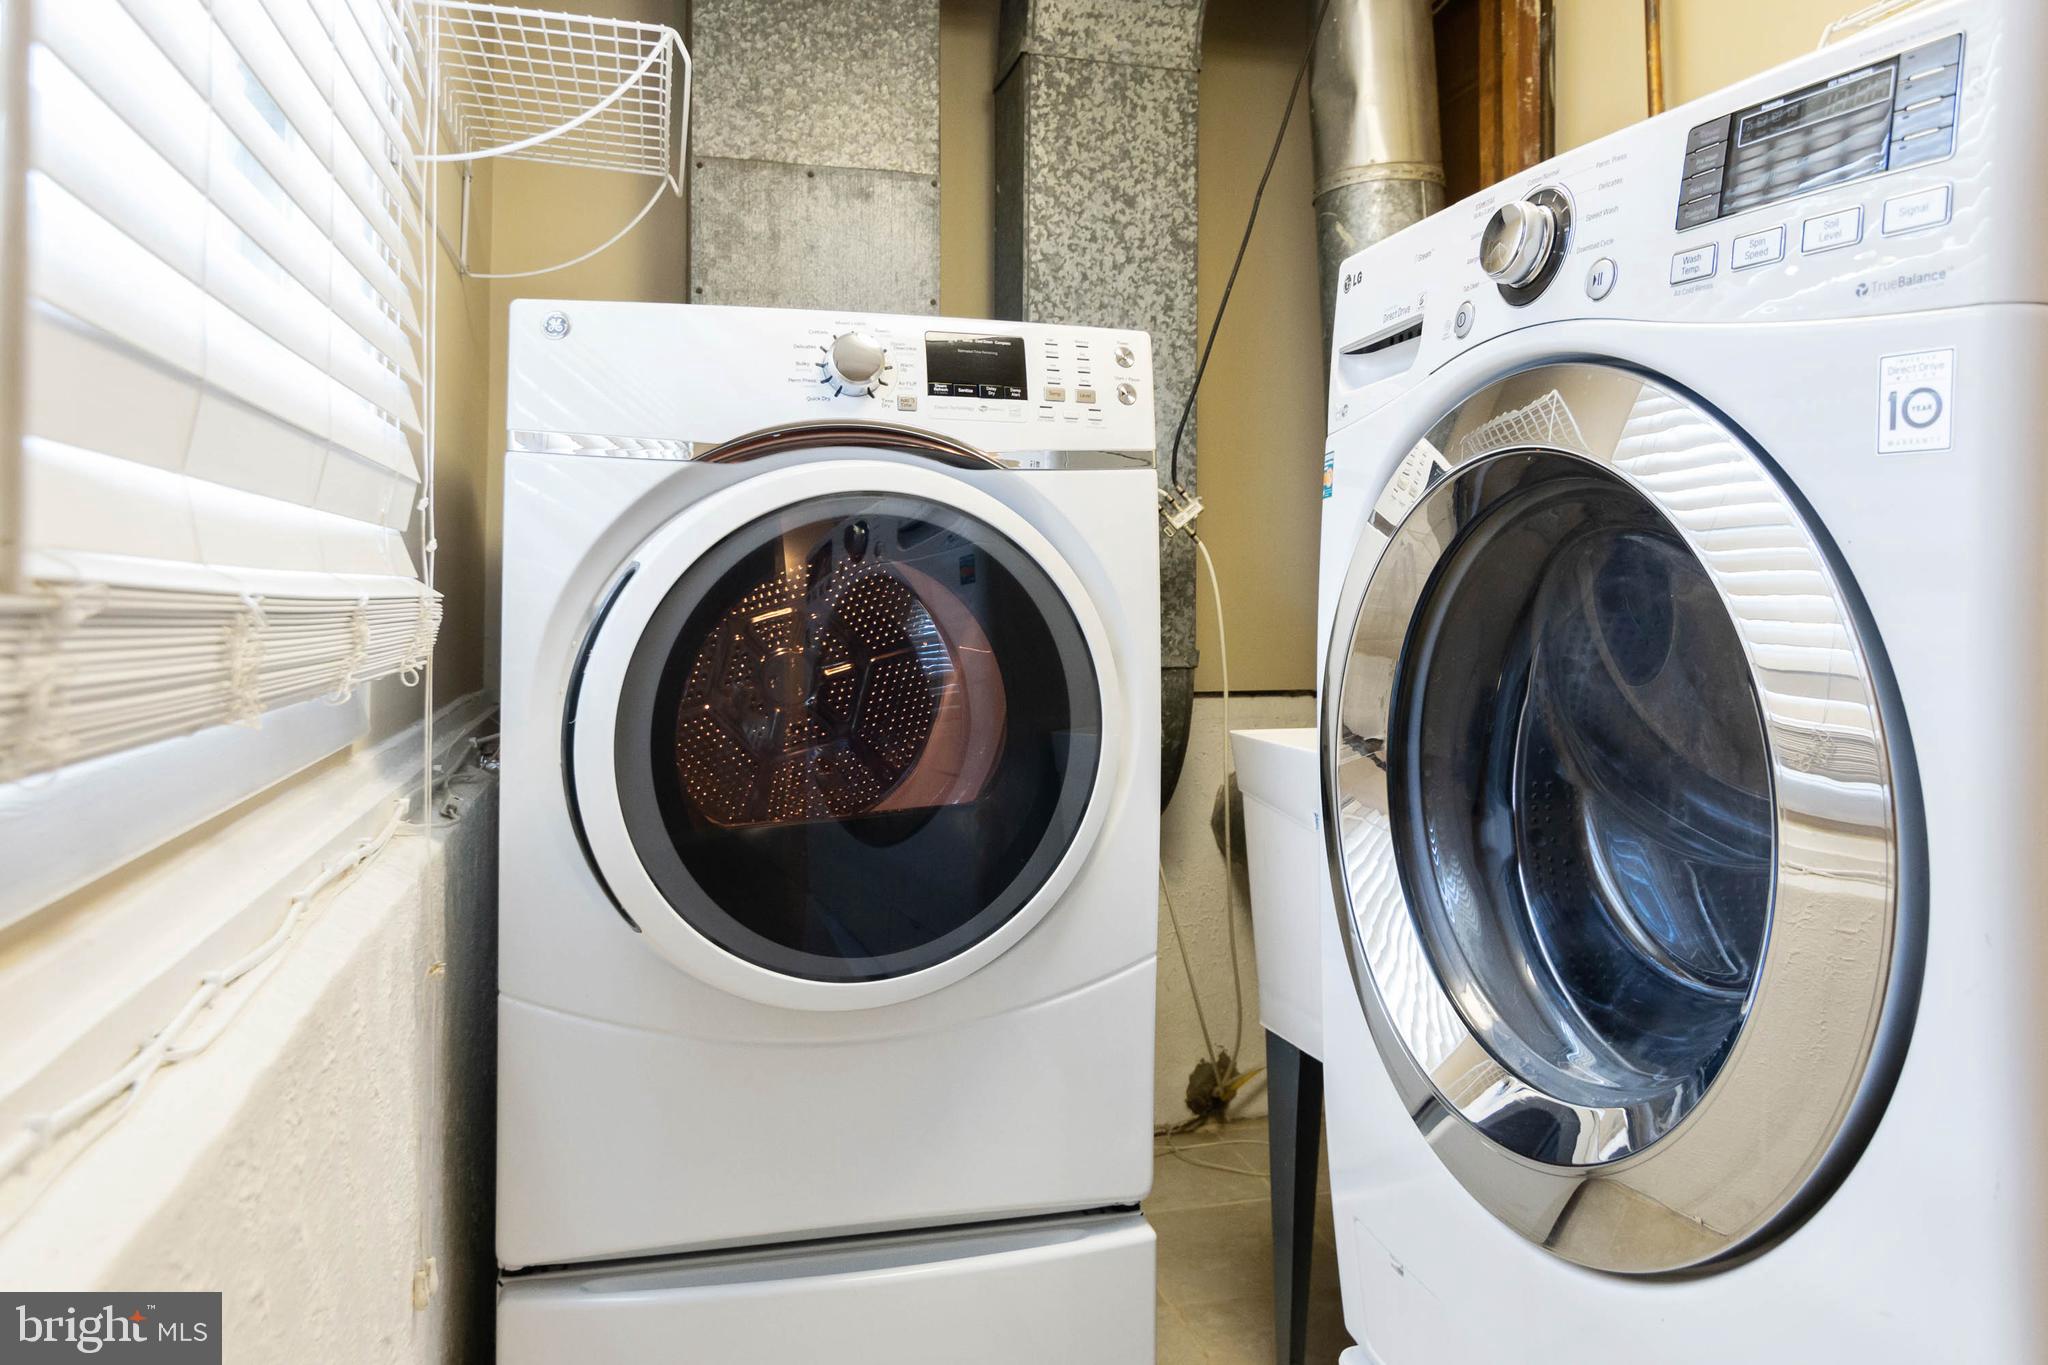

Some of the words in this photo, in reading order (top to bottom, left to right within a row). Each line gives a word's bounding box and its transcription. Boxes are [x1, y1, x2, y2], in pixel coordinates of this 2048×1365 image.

[1898, 203, 1929, 217] Signal
[1823, 218, 1840, 231] Soil
[1818, 230, 1842, 242] Level
[1749, 237, 1766, 249] Spin
[1682, 253, 1702, 265] Wash
[1744, 247, 1769, 260] Speed
[1352, 271, 1363, 287] LG
[1872, 270, 1947, 293] TrueBalance
[1887, 386, 1944, 431] 10
